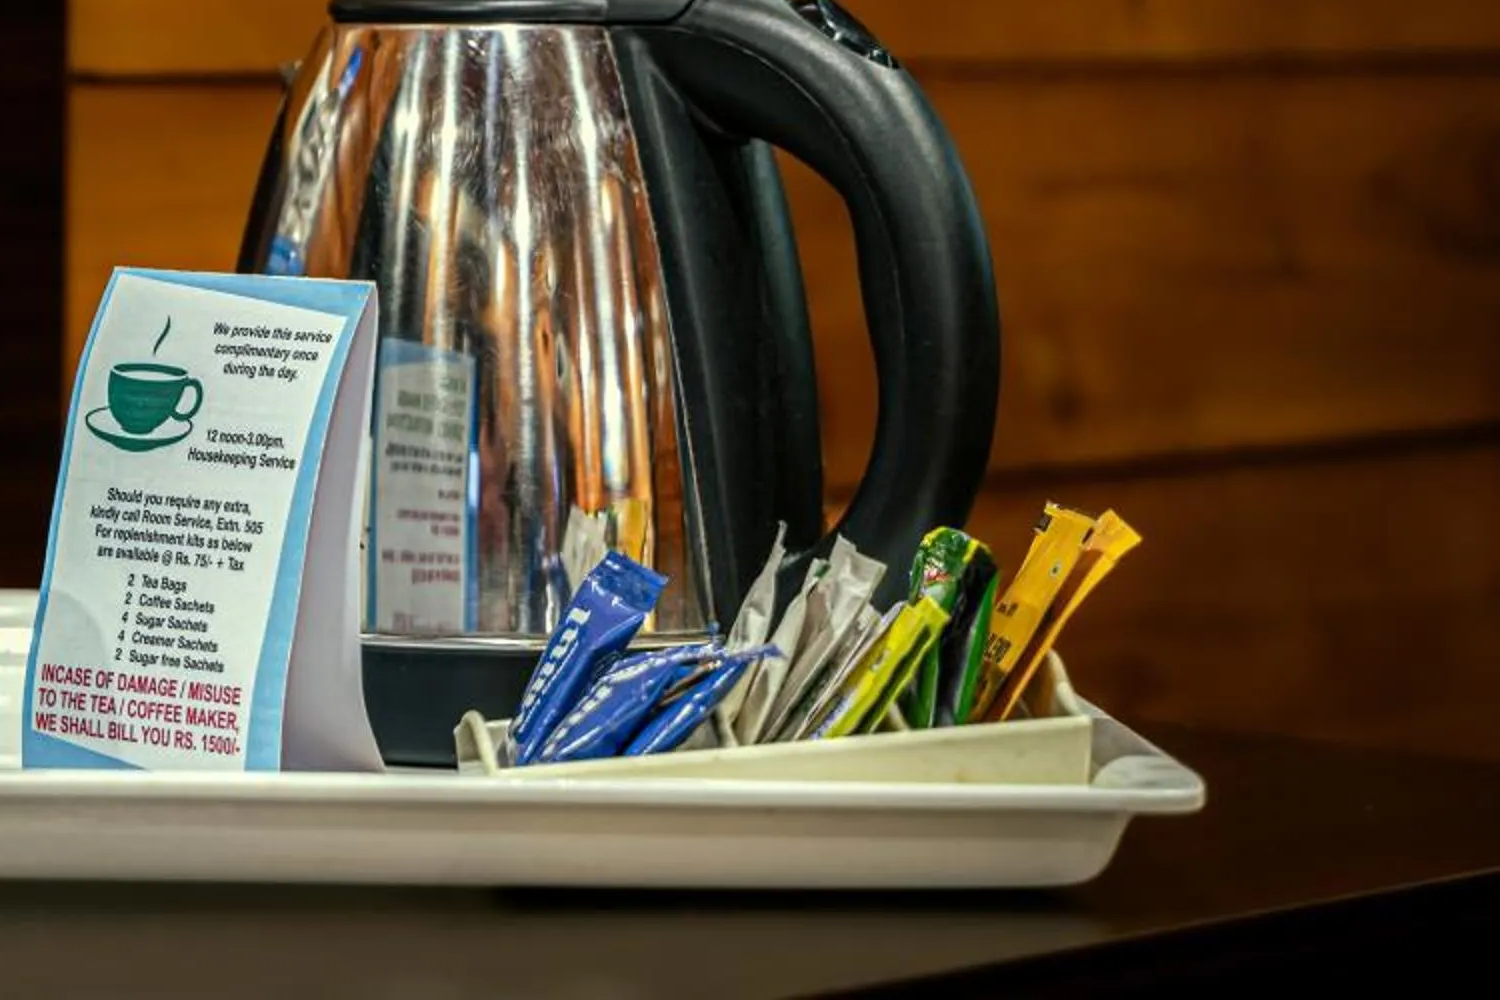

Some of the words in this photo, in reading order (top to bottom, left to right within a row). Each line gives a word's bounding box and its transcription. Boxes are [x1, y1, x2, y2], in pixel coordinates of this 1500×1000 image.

[213, 323, 230, 335] We
[231, 325, 270, 338] provide
[272, 328, 291, 341] this
[294, 331, 333, 344] service
[214, 344, 290, 362] complimentary
[292, 350, 319, 361] once
[223, 362, 256, 379] during
[258, 364, 275, 377] the
[277, 366, 298, 382] day.
[206, 430, 218, 443] 12
[187, 447, 257, 469] Housekeeping
[259, 454, 296, 470] Service
[107, 488, 142, 503] Should
[144, 494, 162, 506] you
[164, 495, 200, 510] require
[202, 500, 222, 514] any
[223, 500, 251, 515] extra,
[90, 506, 119, 522] kindly
[121, 509, 140, 521] call
[142, 510, 171, 525] Room
[174, 514, 212, 531] Service,
[244, 521, 264, 534] 505
[95, 524, 111, 537] For
[113, 528, 184, 546] replenishment
[186, 534, 206, 547] kits
[208, 538, 219, 549] as
[221, 539, 252, 553] below
[97, 545, 113, 557] are
[115, 546, 159, 562] available
[162, 550, 172, 566] @
[175, 552, 191, 566] Rs.
[228, 558, 245, 571] Tax
[128, 574, 135, 586] 2
[142, 575, 158, 589] Tea
[161, 578, 187, 594] Bags
[124, 592, 132, 605] 2
[139, 594, 171, 609] Coffee
[174, 599, 215, 614] Sachets
[121, 612, 128, 623] 4
[135, 613, 165, 630] Sugar
[167, 617, 209, 633] Sachets
[118, 631, 124, 641] 4
[132, 632, 175, 648] Creamer
[177, 637, 218, 653] Sachets
[115, 649, 123, 661] 2
[129, 650, 159, 667] Sugar
[162, 655, 181, 667] free
[184, 658, 224, 673] Sachets
[41, 664, 91, 686] INCASE
[96, 670, 114, 689] OF
[118, 674, 176, 697] DAMAGE
[188, 681, 241, 705] MISUSE
[38, 688, 56, 707] TO
[61, 691, 86, 711] THE
[91, 695, 116, 715] TEA
[128, 699, 182, 723] COFFEE
[186, 707, 239, 735] MAKER,
[36, 712, 56, 731] WE
[60, 716, 104, 738] SHALL
[108, 721, 138, 742] BILL
[141, 725, 171, 746] YOU
[174, 731, 196, 751] RS.
[202, 735, 241, 755] 1500/-
